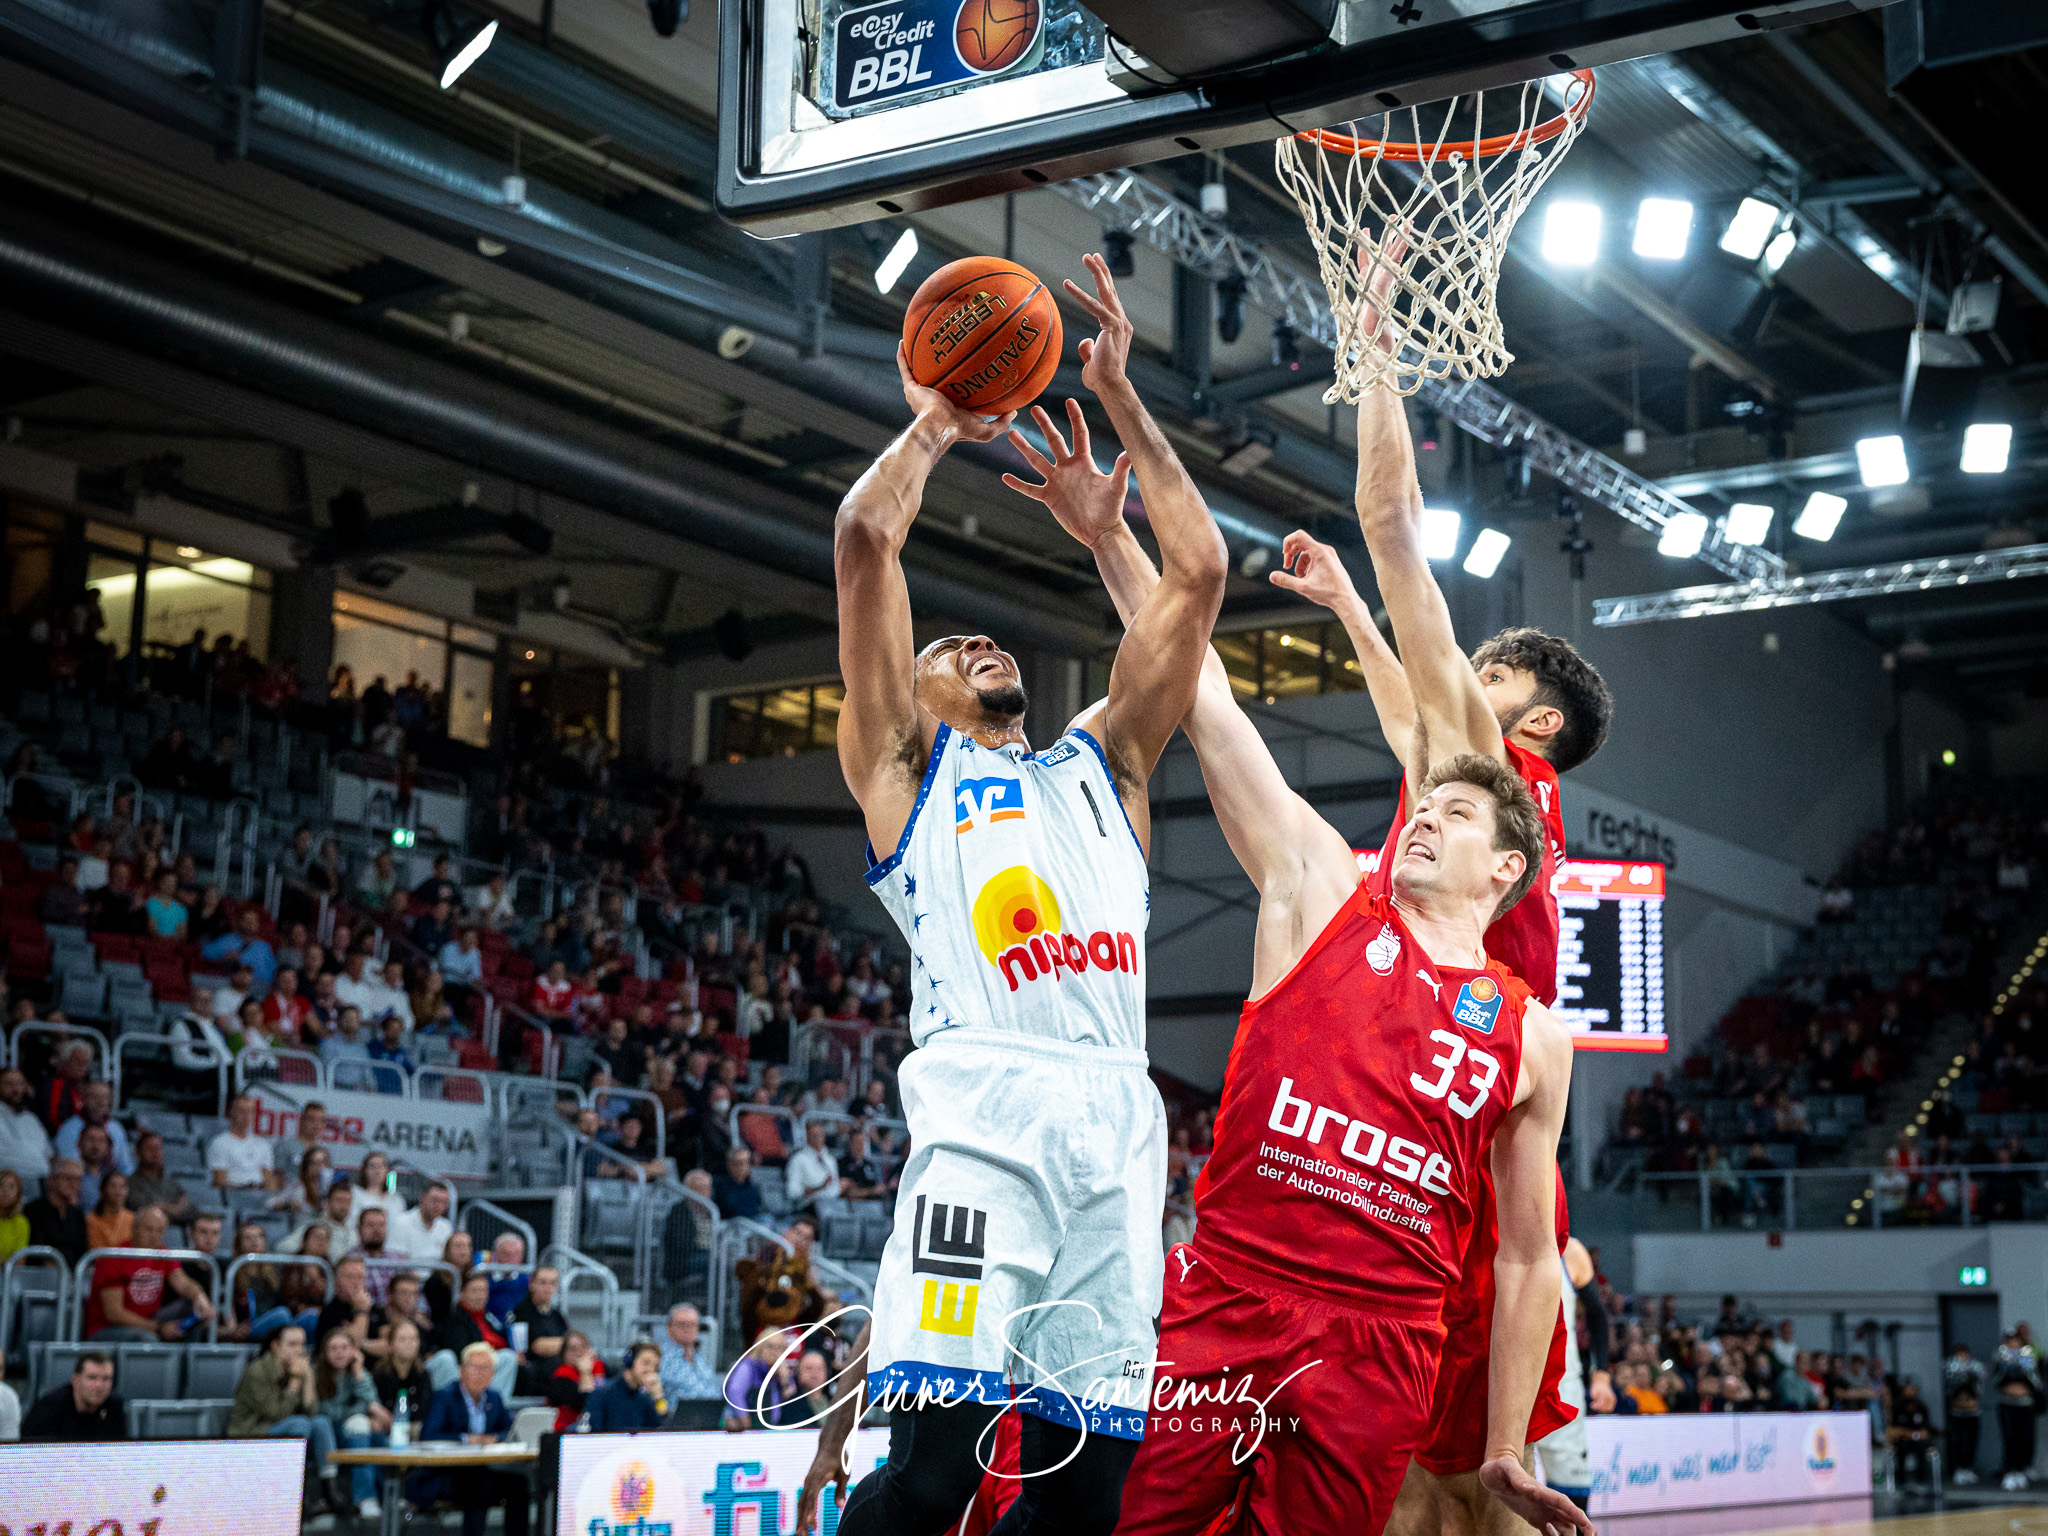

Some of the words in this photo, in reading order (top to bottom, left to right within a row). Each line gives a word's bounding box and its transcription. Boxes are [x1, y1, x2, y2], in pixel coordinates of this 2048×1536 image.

[874, 20, 935, 50] Credit
[848, 44, 932, 99] BBL
[932, 293, 1008, 365] LEGACY
[948, 315, 1041, 400] SPALDING
[1045, 749, 1075, 766] BBL
[1587, 809, 1677, 871] rechts
[1456, 1009, 1488, 1029] BBL
[1409, 1028, 1501, 1120] 33
[254, 1097, 365, 1146] brse
[371, 1119, 477, 1155] ARENA
[1267, 1076, 1453, 1197] brose
[1256, 1162, 1285, 1182] der
[1286, 1171, 1433, 1235] Automobilindustrie
[1259, 1141, 1377, 1193] Internationaler
[1378, 1181, 1433, 1216] Partner
